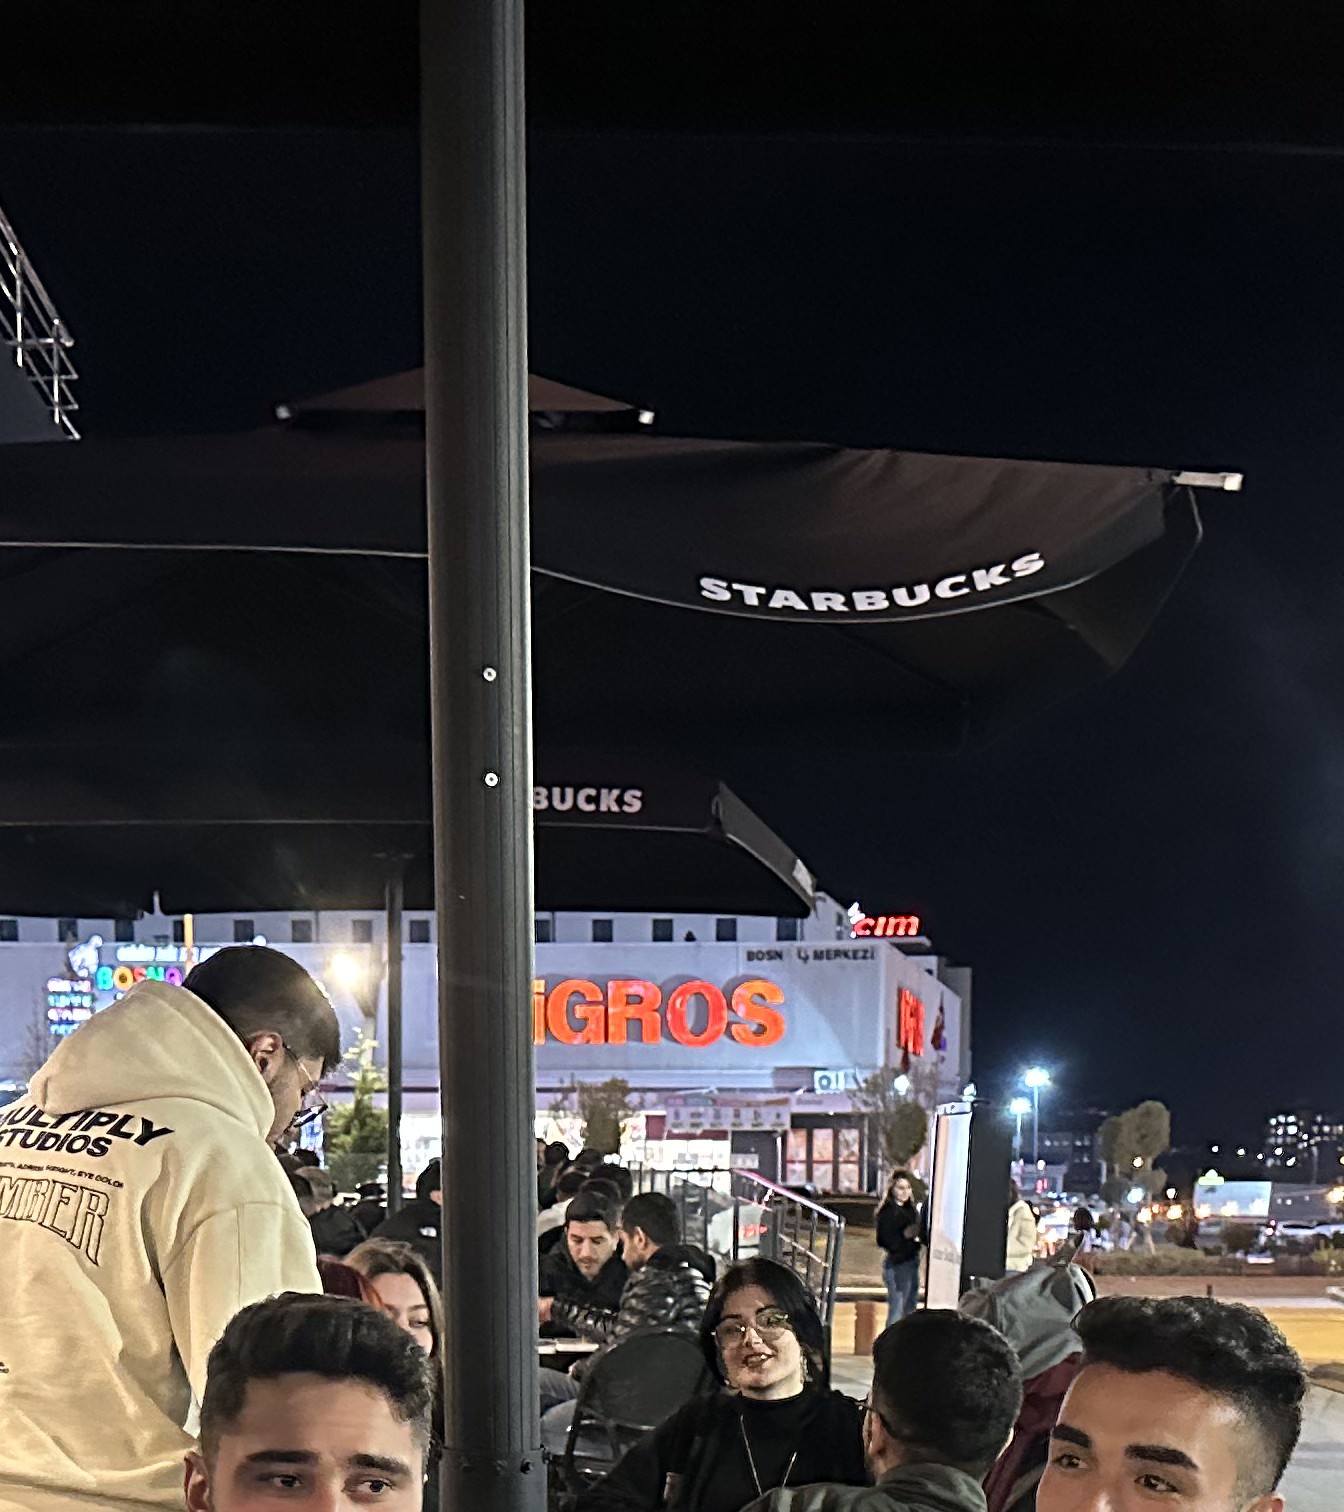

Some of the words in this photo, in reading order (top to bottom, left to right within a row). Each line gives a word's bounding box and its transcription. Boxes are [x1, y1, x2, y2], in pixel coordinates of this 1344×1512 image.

[699, 552, 1045, 612] STARBUCKS
[533, 786, 643, 813] BUCKS
[746, 949, 784, 961] BOSN
[532, 979, 786, 1048] iGROS
